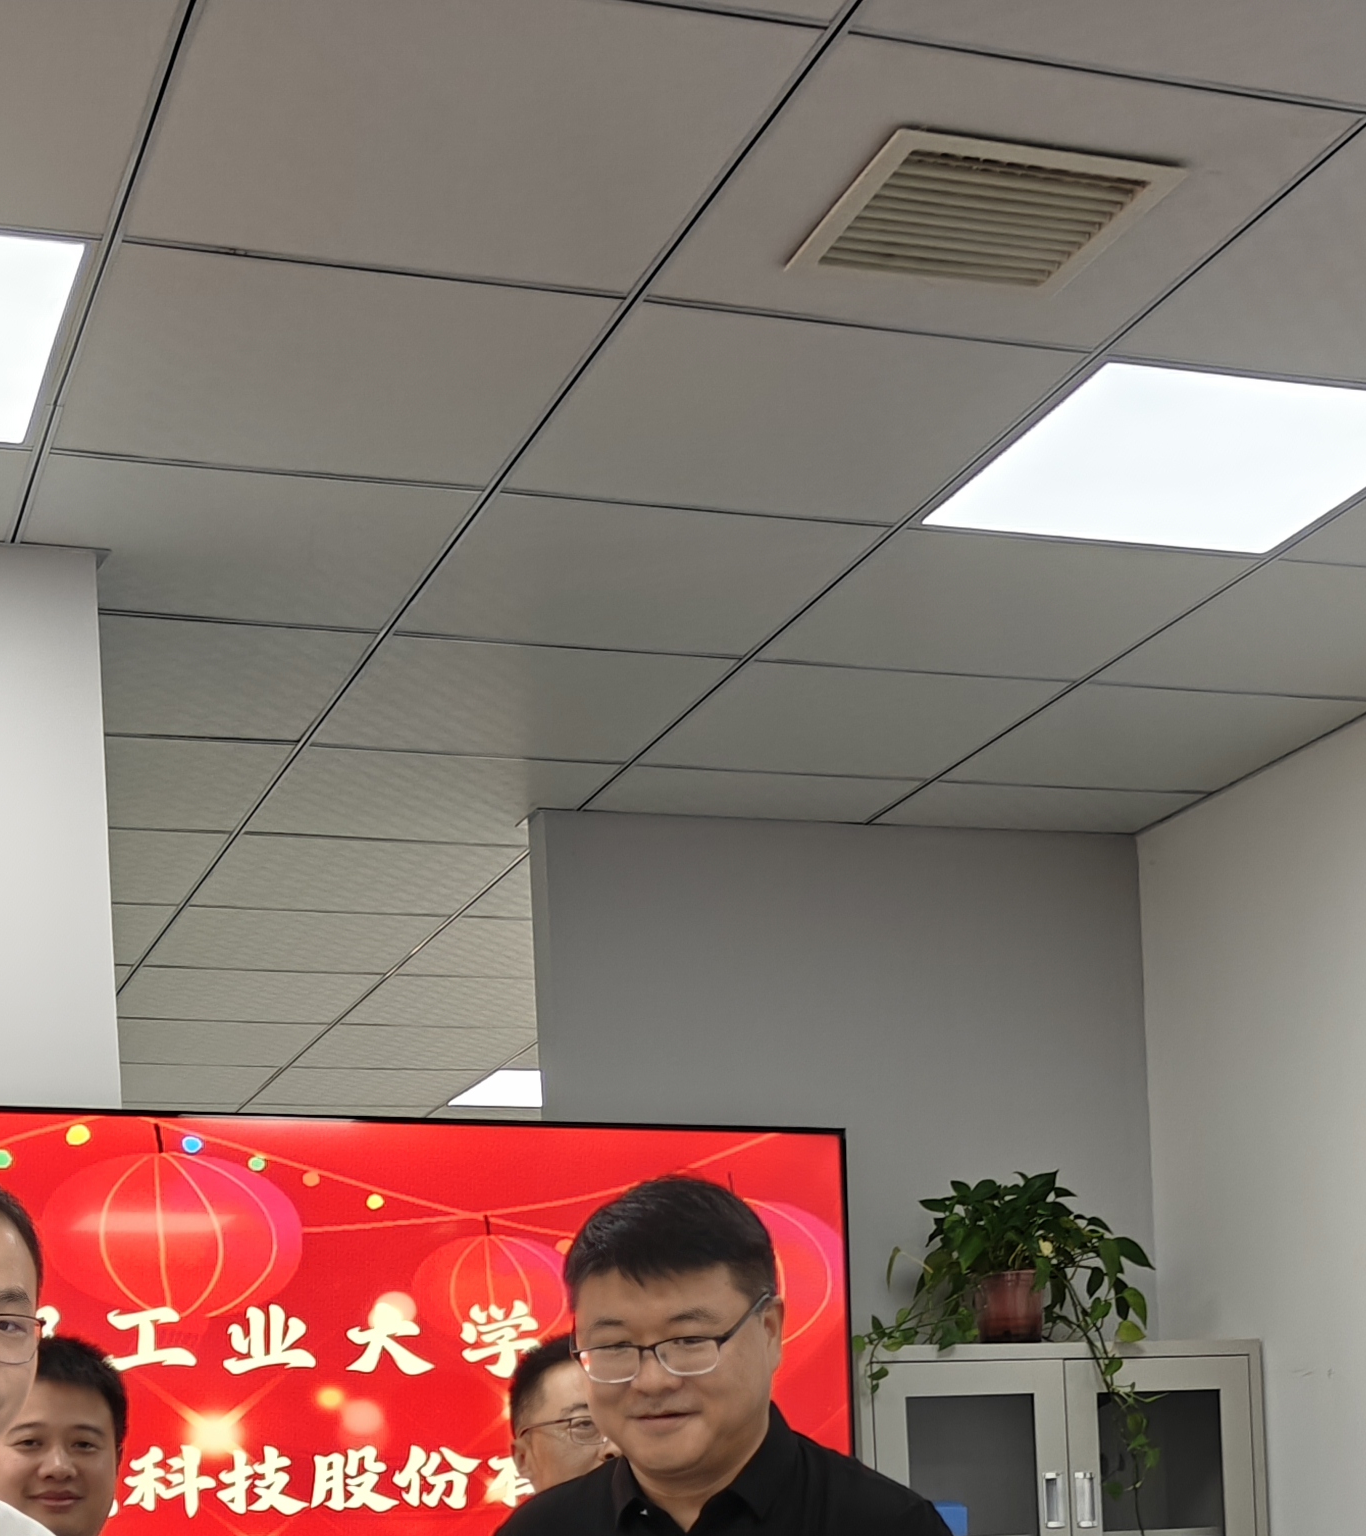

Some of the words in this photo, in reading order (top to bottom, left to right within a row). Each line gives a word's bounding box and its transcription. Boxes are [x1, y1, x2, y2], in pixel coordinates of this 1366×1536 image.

[35, 1298, 539, 1379] 工业大学
[109, 1444, 535, 1519] 科技股份
